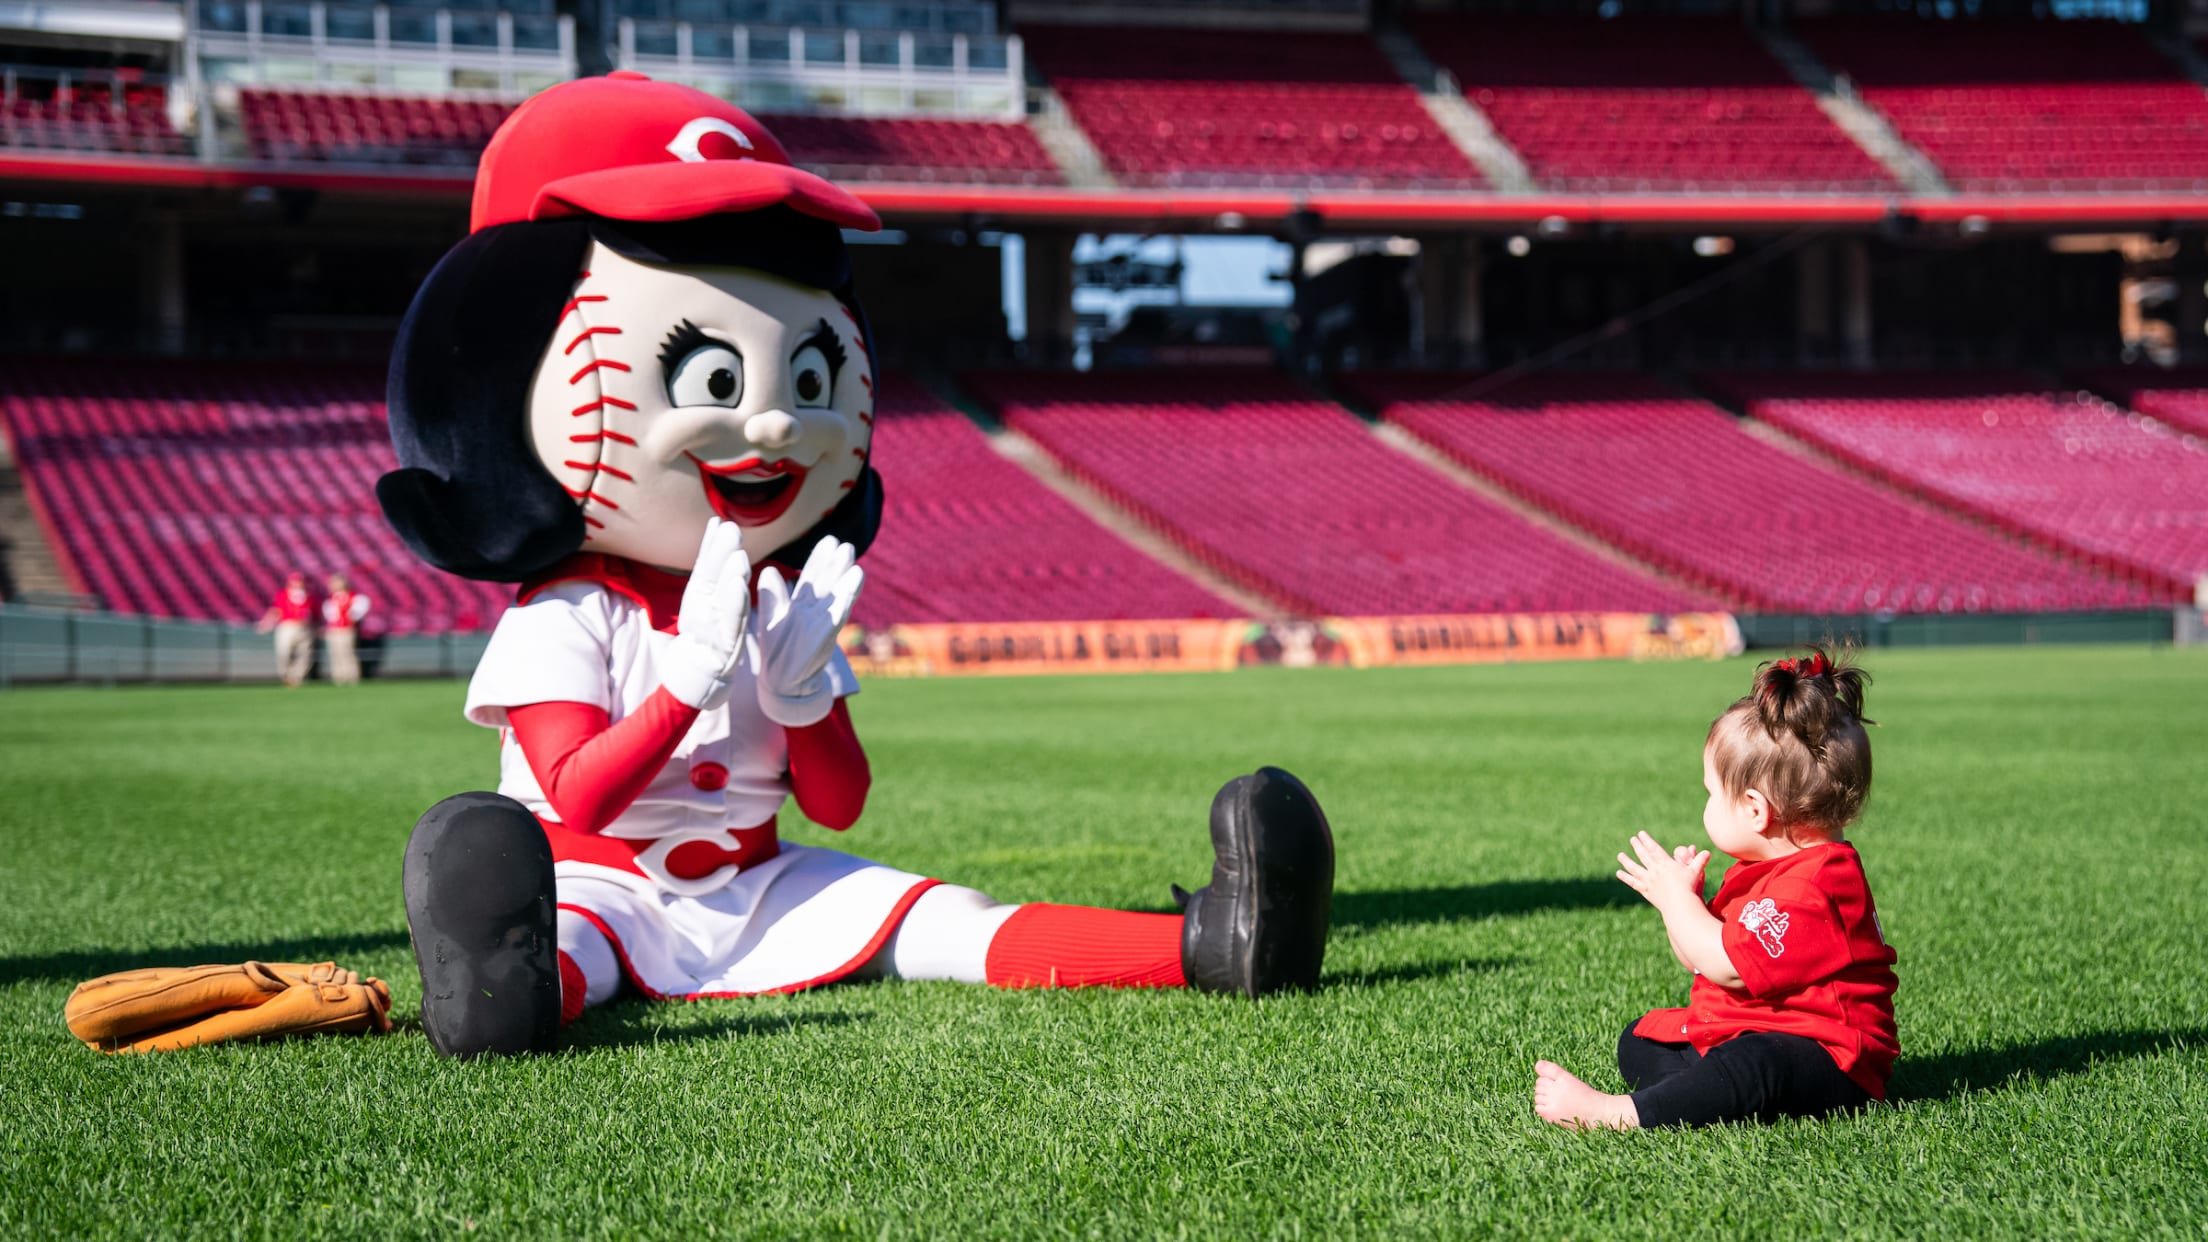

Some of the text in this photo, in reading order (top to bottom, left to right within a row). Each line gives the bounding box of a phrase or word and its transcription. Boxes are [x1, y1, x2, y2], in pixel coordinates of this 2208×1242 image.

[665, 116, 755, 163] C
[633, 830, 741, 897] C
[1757, 898, 1789, 936] Reds
